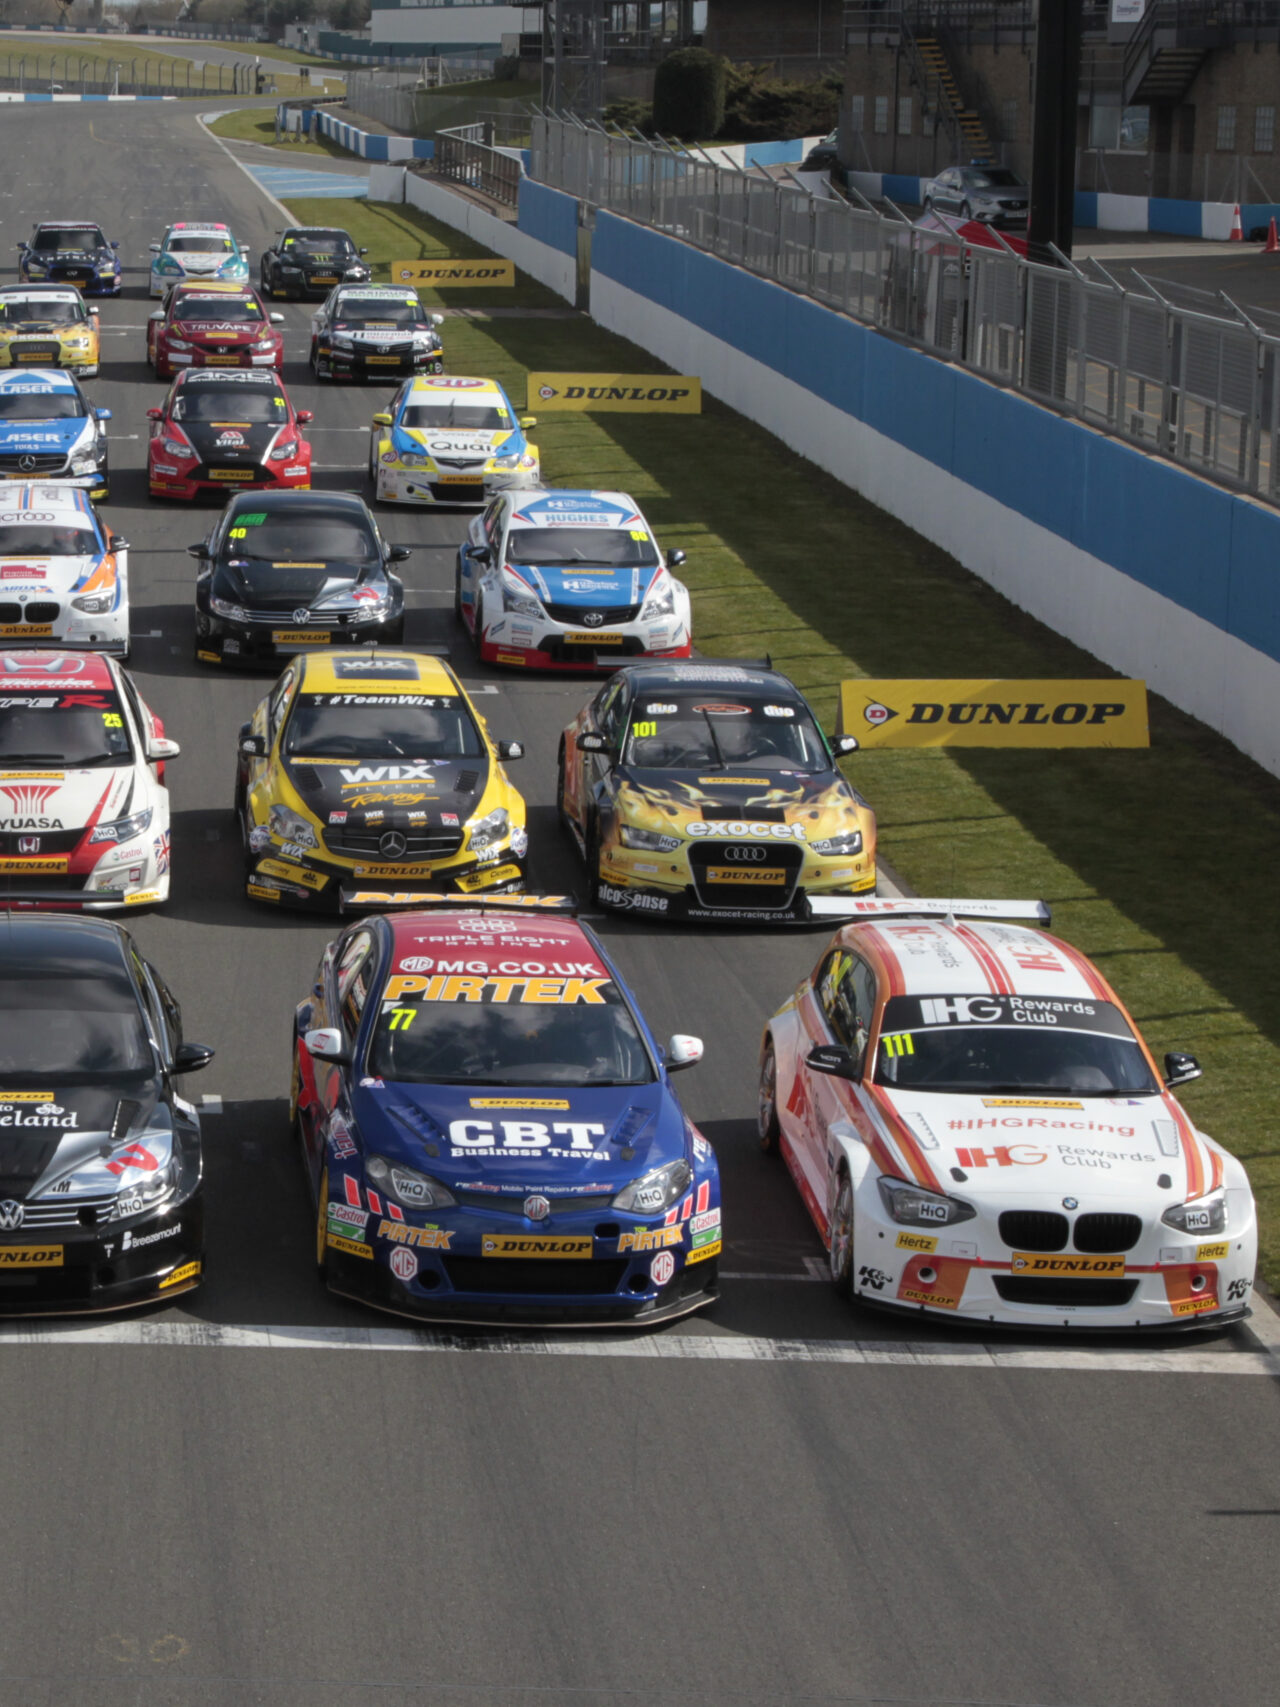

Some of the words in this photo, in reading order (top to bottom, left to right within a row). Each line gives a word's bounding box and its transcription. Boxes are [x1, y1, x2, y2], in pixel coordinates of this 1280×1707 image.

[417, 268, 506, 279] DUNLOP
[191, 323, 252, 332] TRUVAPE
[188, 372, 272, 380] AMD
[431, 378, 478, 387] STP
[0, 385, 54, 394] LASER
[563, 386, 690, 401] DUNLOP
[545, 514, 608, 523] HUGHES
[229, 528, 247, 539] 40
[5, 626, 53, 634] DUNLOP
[574, 634, 622, 642] DUNLOP
[341, 660, 405, 669] WIX
[329, 695, 436, 706] #TeamWix
[647, 704, 678, 715] duo
[763, 705, 795, 717] duo
[905, 703, 1126, 725] DUNLOP
[102, 713, 123, 728] 25
[632, 721, 657, 738] 101
[339, 764, 436, 783] WIX
[342, 792, 441, 808] Racing
[365, 810, 384, 818] WIX
[97, 827, 117, 837] HiQ
[685, 821, 806, 840] exocet
[297, 833, 314, 846] HiQ
[471, 837, 488, 848] HiQ
[659, 836, 679, 849] HiQ
[813, 841, 831, 851] HiQ
[119, 848, 143, 860] Castrol
[281, 842, 306, 858] WIX
[475, 848, 499, 862] WIX
[2, 861, 67, 870] DUNLOP
[367, 866, 431, 875] DUNLOP
[720, 870, 785, 881] DUNLOP
[129, 891, 160, 901] DUNLOP
[349, 892, 568, 906] PIRTEK
[688, 908, 796, 919] www.exocet-racing.co.uk
[413, 935, 494, 944] TRIPLE
[498, 935, 571, 946] EIGHT
[436, 960, 602, 976] MG.CO.UK
[381, 974, 615, 1004] PIRTEK
[920, 996, 1002, 1024] IHG
[1011, 997, 1096, 1016] Rewards
[1013, 1009, 1058, 1025] Club
[389, 1009, 418, 1031] 77
[882, 1033, 915, 1058] 111
[488, 1099, 568, 1108] DUNLOP
[1001, 1099, 1081, 1108] DUNLOP
[449, 1119, 605, 1150] CBT
[947, 1117, 1136, 1138] #IHGRacing
[451, 1147, 542, 1158] Business
[548, 1148, 610, 1161] Travel
[955, 1144, 1049, 1168] IHG
[1057, 1144, 1156, 1163] Rewards
[1061, 1155, 1112, 1170] Club
[398, 1180, 424, 1197] HiQ
[639, 1189, 663, 1206] HiQ
[120, 1200, 143, 1215] HiQ
[335, 1204, 366, 1225] Castrol
[920, 1203, 946, 1220] HiQ
[696, 1212, 720, 1231] Castrol
[1187, 1212, 1210, 1227] HiQ
[132, 1222, 182, 1248] Breezemount
[377, 1219, 456, 1250] PIRTEK
[617, 1223, 684, 1253] PIRTEK
[335, 1239, 370, 1255] DUNLOP
[503, 1241, 591, 1252] DUNLOP
[899, 1235, 933, 1249] Hertz
[692, 1243, 720, 1260] DUNLOP
[1198, 1245, 1225, 1259] Hertz
[393, 1251, 415, 1277] MG
[653, 1255, 672, 1281] MG
[1032, 1259, 1124, 1271] DUNLOP
[167, 1264, 198, 1281] DUNLOP
[905, 1289, 955, 1305] DUNLOP
[1178, 1299, 1218, 1312] DUNLOP
